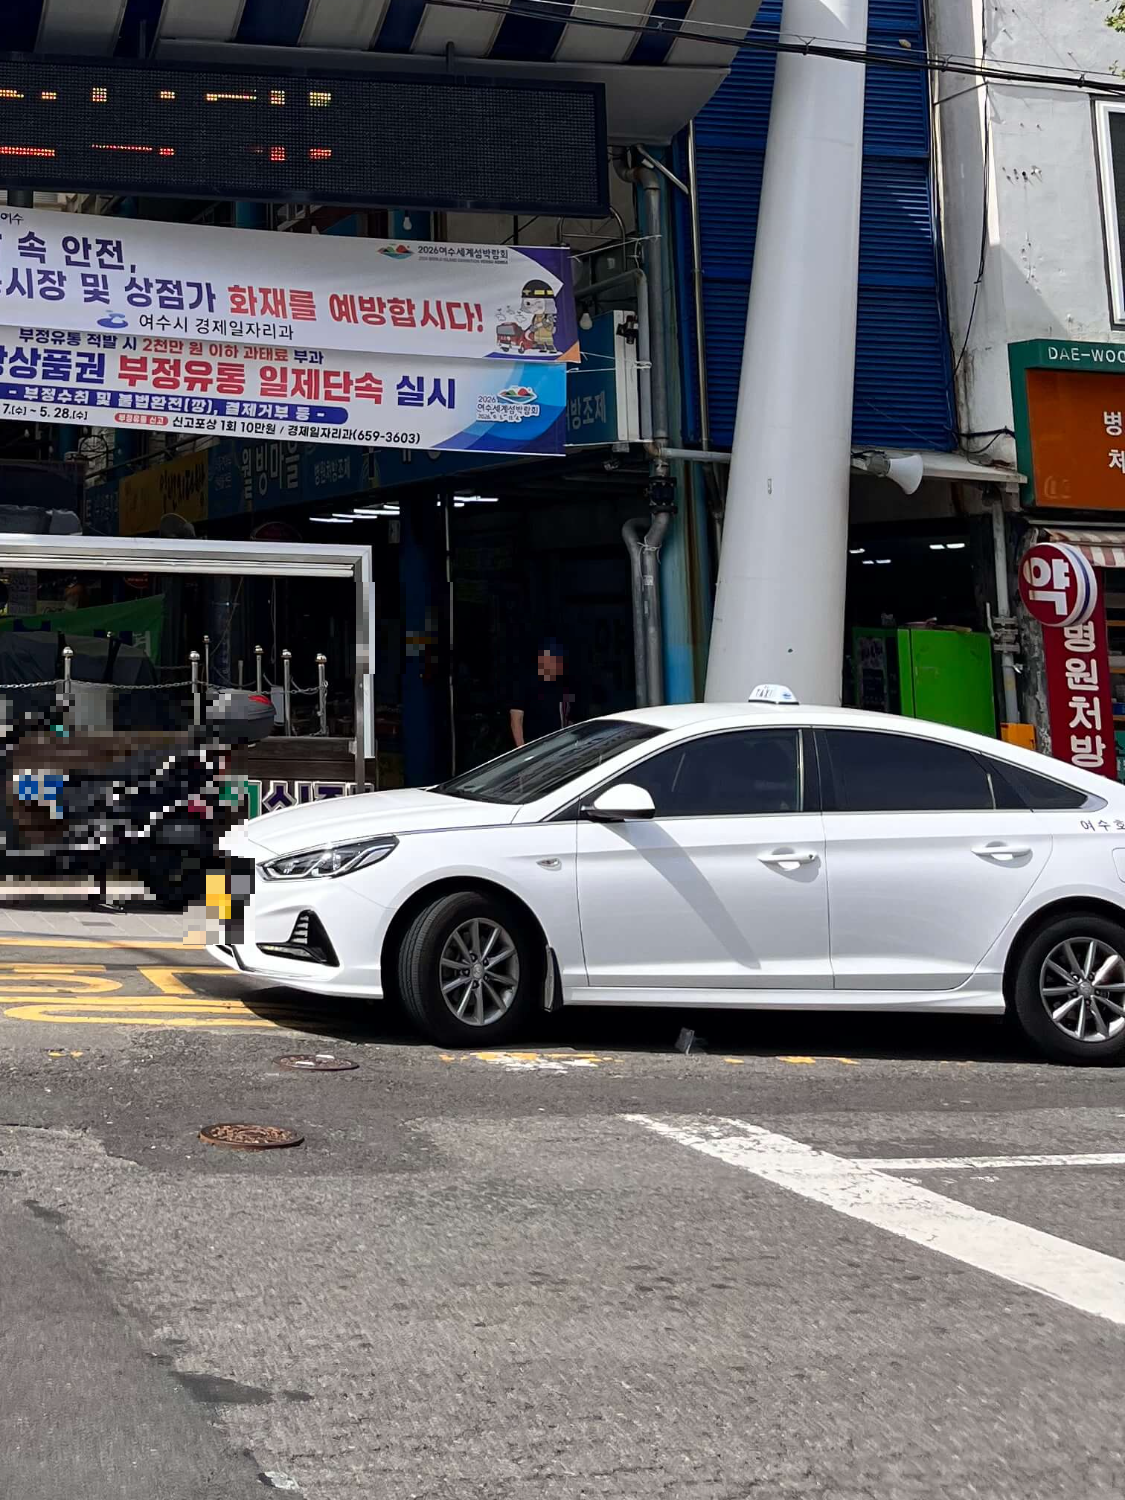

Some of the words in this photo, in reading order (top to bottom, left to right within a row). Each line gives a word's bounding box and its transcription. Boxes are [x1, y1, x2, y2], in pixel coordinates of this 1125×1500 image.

[17, 231, 46, 264] 속
[61, 235, 136, 274] 안전,
[80, 272, 110, 305] 및
[124, 275, 216, 313] 상점가
[227, 284, 317, 323] 화재를
[328, 292, 484, 334] 예방합시다!
[18, 327, 82, 347] 부정유통
[87, 333, 118, 350] 적발
[122, 336, 137, 351] 시
[142, 337, 185, 354] 2천만
[188, 341, 203, 356] 원
[209, 343, 239, 359] 이하
[243, 345, 289, 362] 과태료
[293, 349, 324, 365] 부과
[138, 313, 188, 333] 여수시
[195, 317, 294, 341] 경제일자리과
[117, 354, 247, 396] 부정유통
[258, 364, 384, 405] 일제단속
[395, 374, 457, 410] 실시
[23, 386, 90, 405] 부정수취
[96, 391, 112, 406] 및
[225, 401, 289, 420] 결제거부
[295, 406, 310, 421] 등
[567, 390, 607, 431] 방조제
[172, 416, 217, 431] 신고포상
[220, 419, 237, 432] 1회
[241, 421, 276, 435] 10만원
[1023, 557, 1071, 617] 약
[1063, 620, 1107, 769] 병원처방
